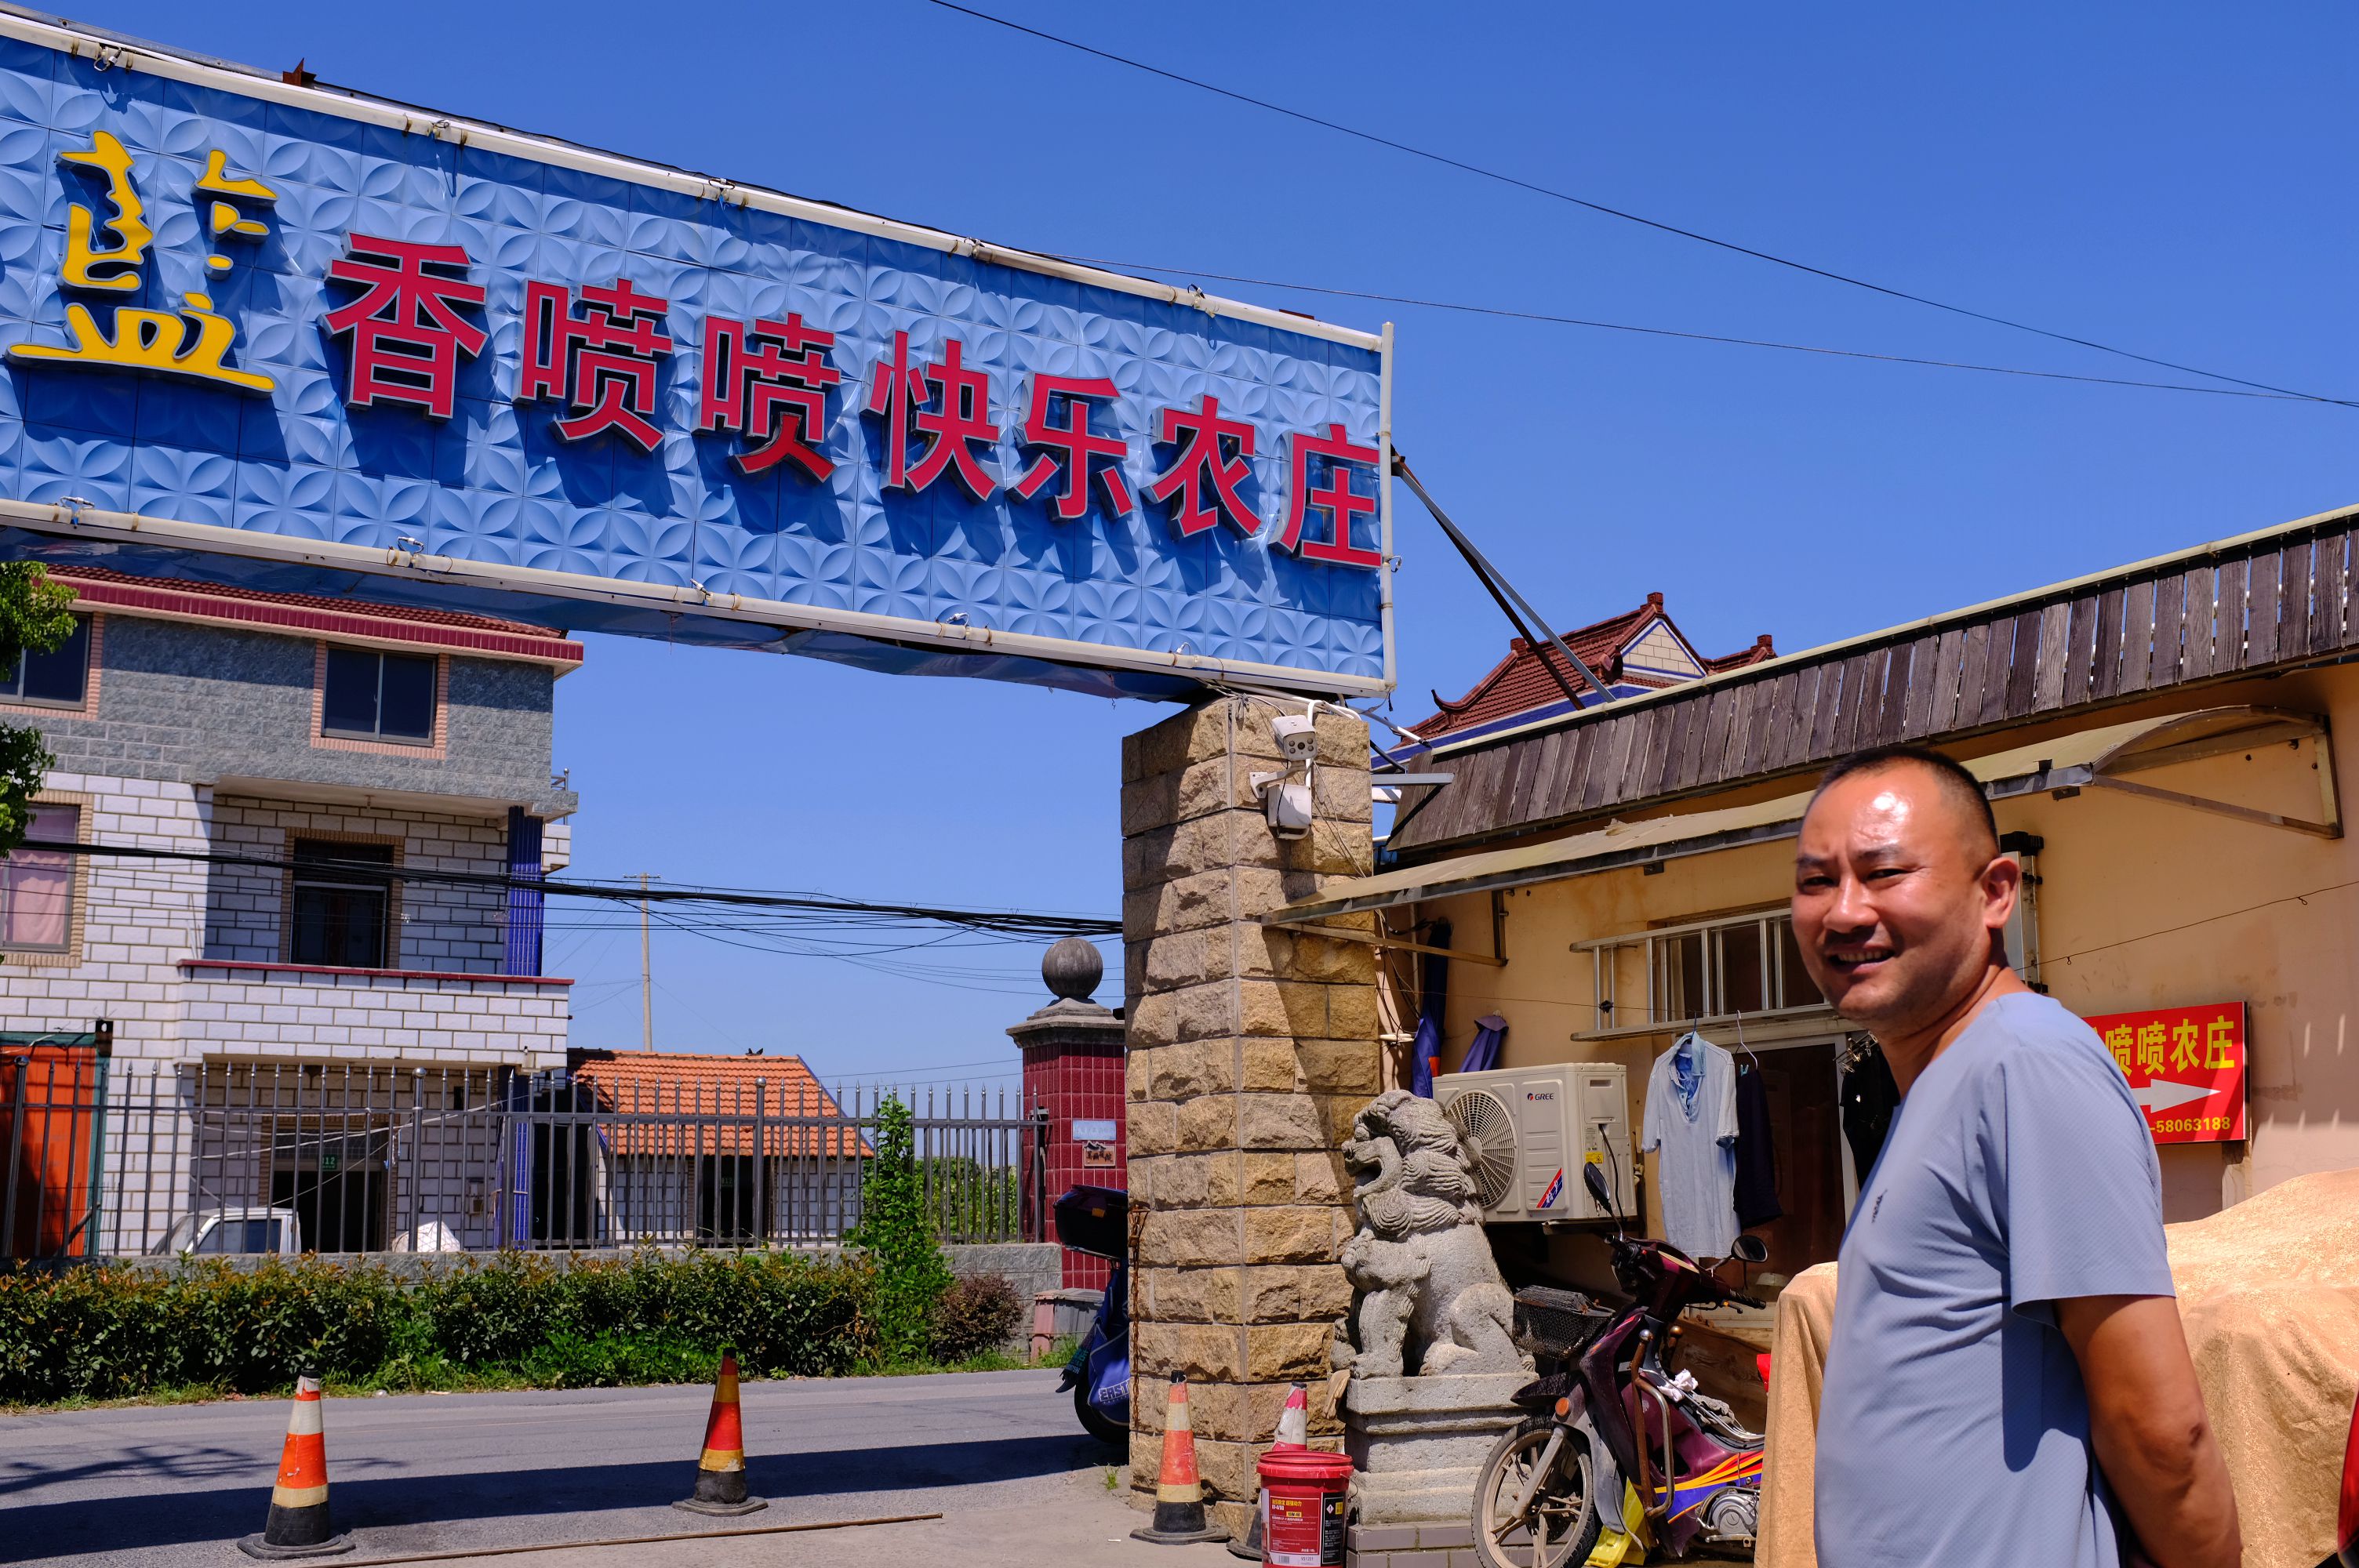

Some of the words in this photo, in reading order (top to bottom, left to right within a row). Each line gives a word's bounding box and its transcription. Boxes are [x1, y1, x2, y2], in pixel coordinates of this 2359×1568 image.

[322, 230, 1382, 568] 香喷喷快乐农庄
[2092, 1015, 2235, 1076] 喷喷农庄
